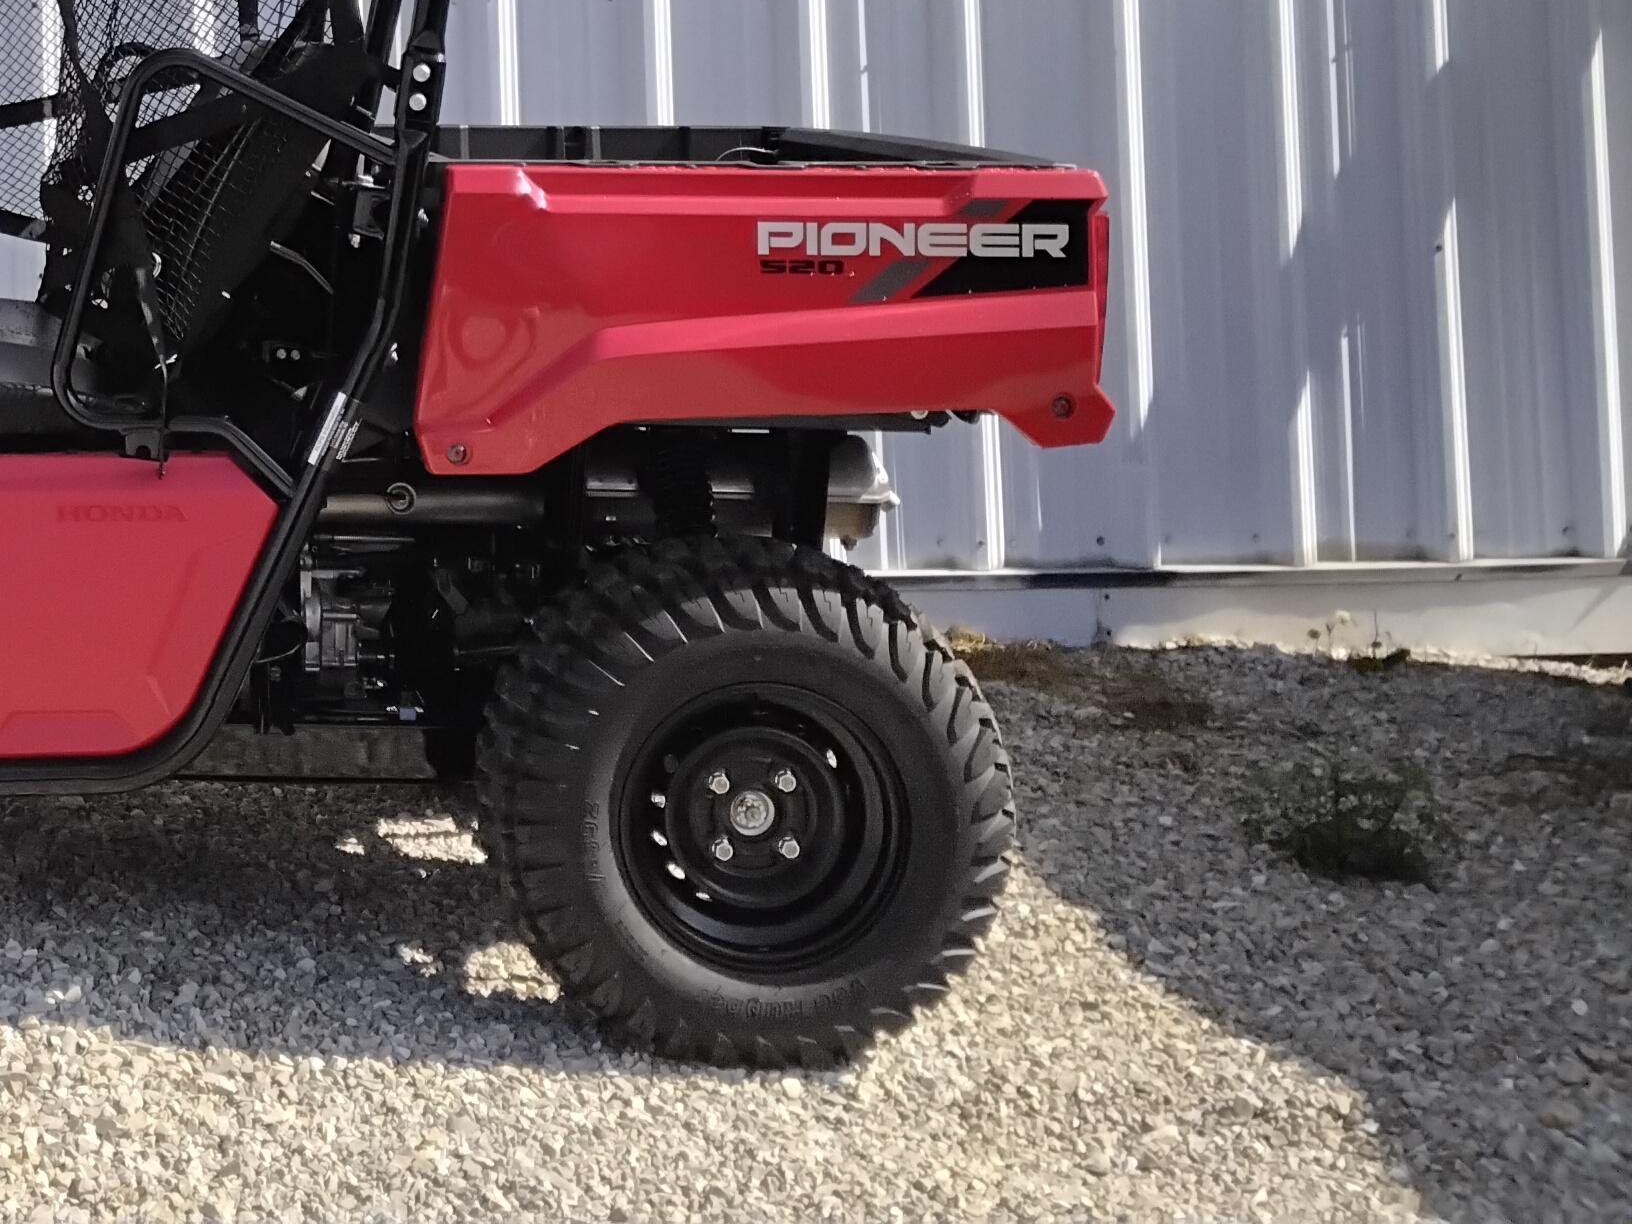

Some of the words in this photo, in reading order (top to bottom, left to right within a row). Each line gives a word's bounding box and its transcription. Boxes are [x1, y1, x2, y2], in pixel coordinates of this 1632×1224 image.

[756, 221, 1070, 258] PIONEER
[759, 260, 845, 275] 520
[55, 504, 189, 523] HONDA
